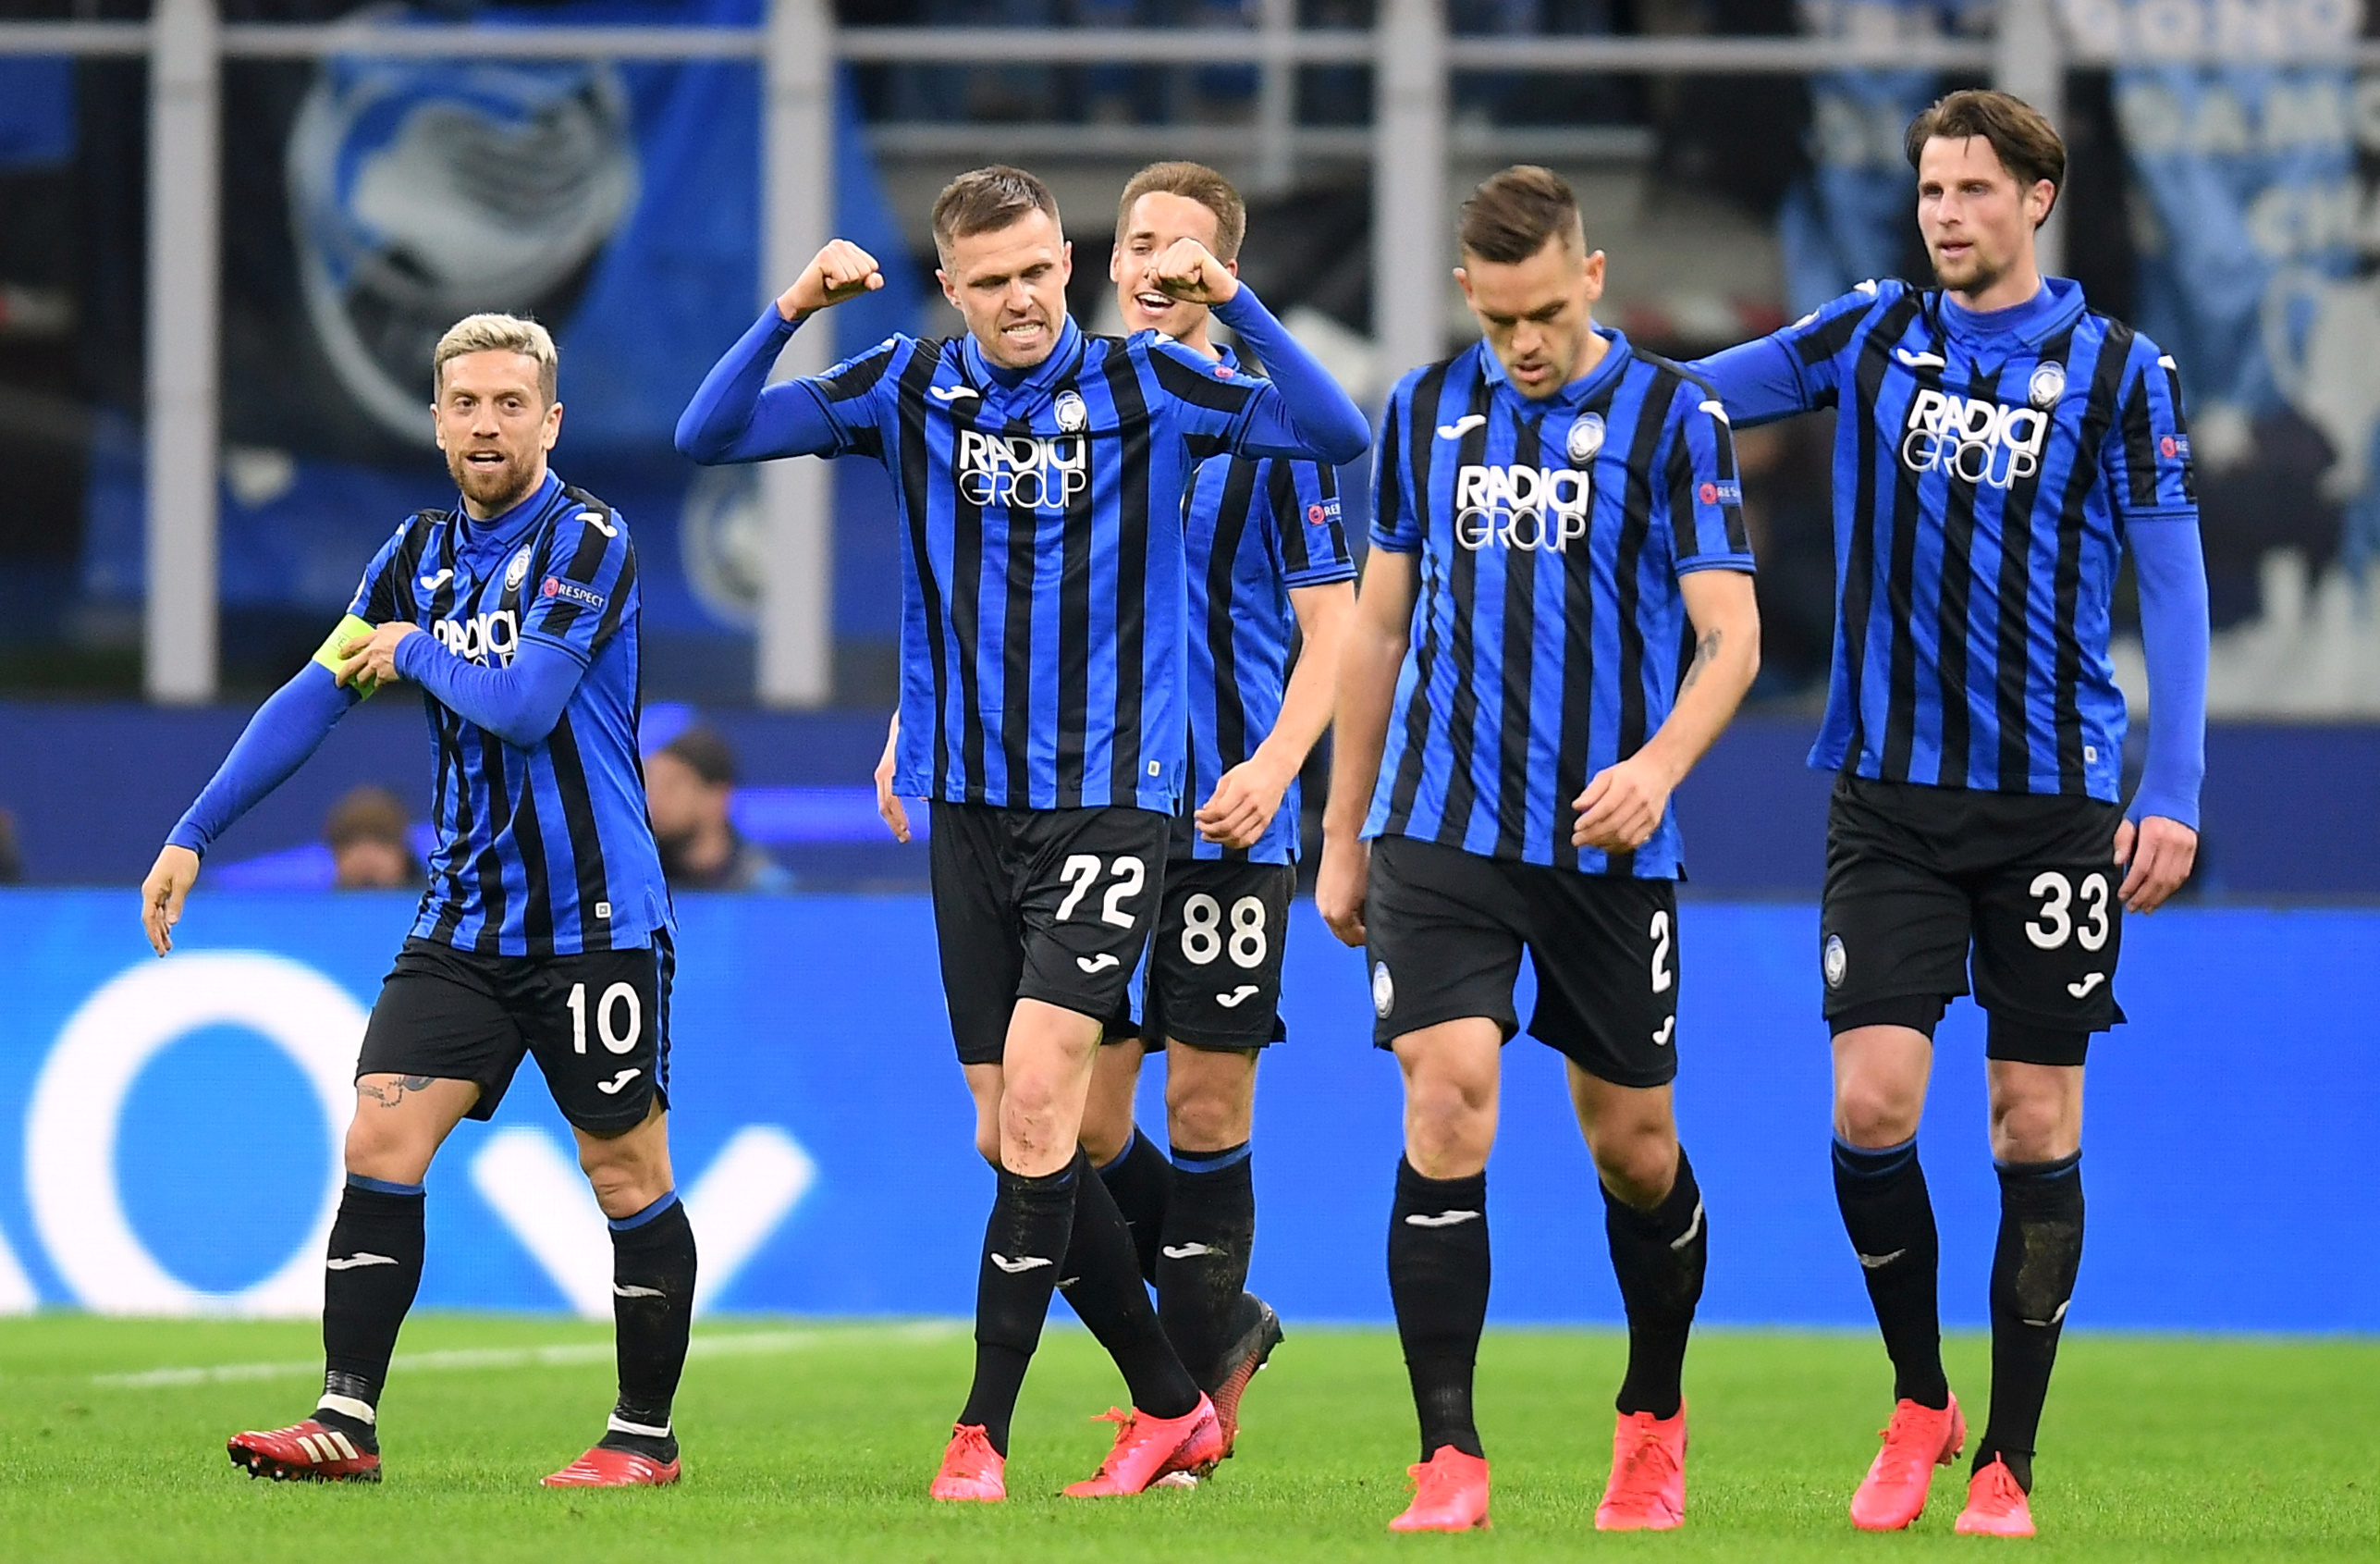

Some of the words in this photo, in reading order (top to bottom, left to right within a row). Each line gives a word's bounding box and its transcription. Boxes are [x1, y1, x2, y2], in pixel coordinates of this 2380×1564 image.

[959, 429, 1086, 472] RADICI
[1908, 388, 2048, 456] RADICI
[959, 469, 1086, 508] GROUP
[1456, 464, 1589, 515] RADICI
[1902, 428, 2037, 491] GROUP
[1455, 506, 1586, 554] GROUP
[558, 584, 605, 609] RESPECT
[433, 610, 520, 659] RADICI
[1055, 854, 1146, 930] 72
[2025, 871, 2109, 951] 33
[1181, 893, 1268, 968] 88
[1650, 910, 1672, 994] 2
[566, 981, 642, 1056] 10
